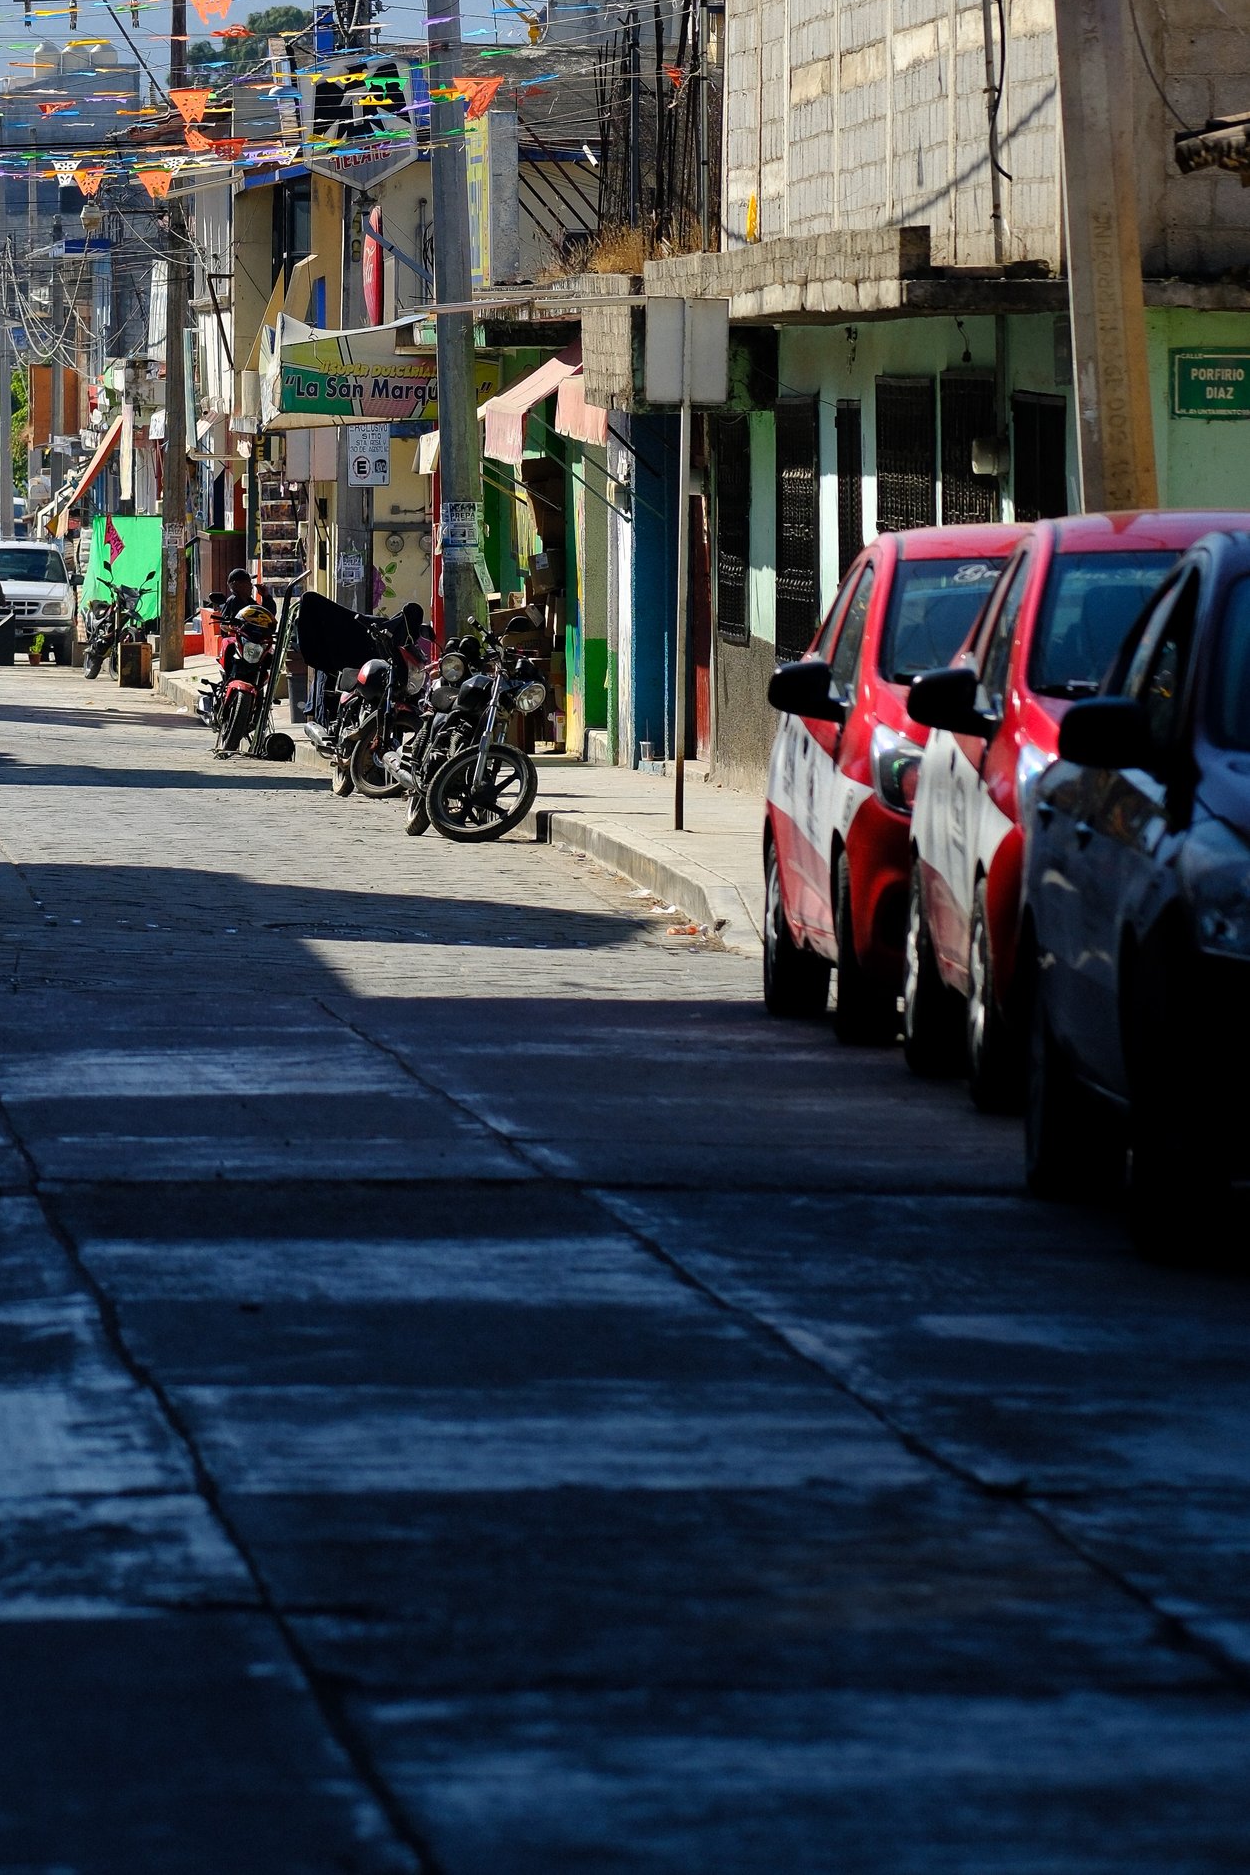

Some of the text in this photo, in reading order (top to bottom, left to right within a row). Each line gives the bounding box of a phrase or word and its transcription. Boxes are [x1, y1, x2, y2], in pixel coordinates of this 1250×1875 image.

[1190, 368, 1245, 381] PORFIRIO
[325, 376, 364, 399] San
[1205, 386, 1235, 400] DIAZ
[450, 512, 476, 520] PREPA
